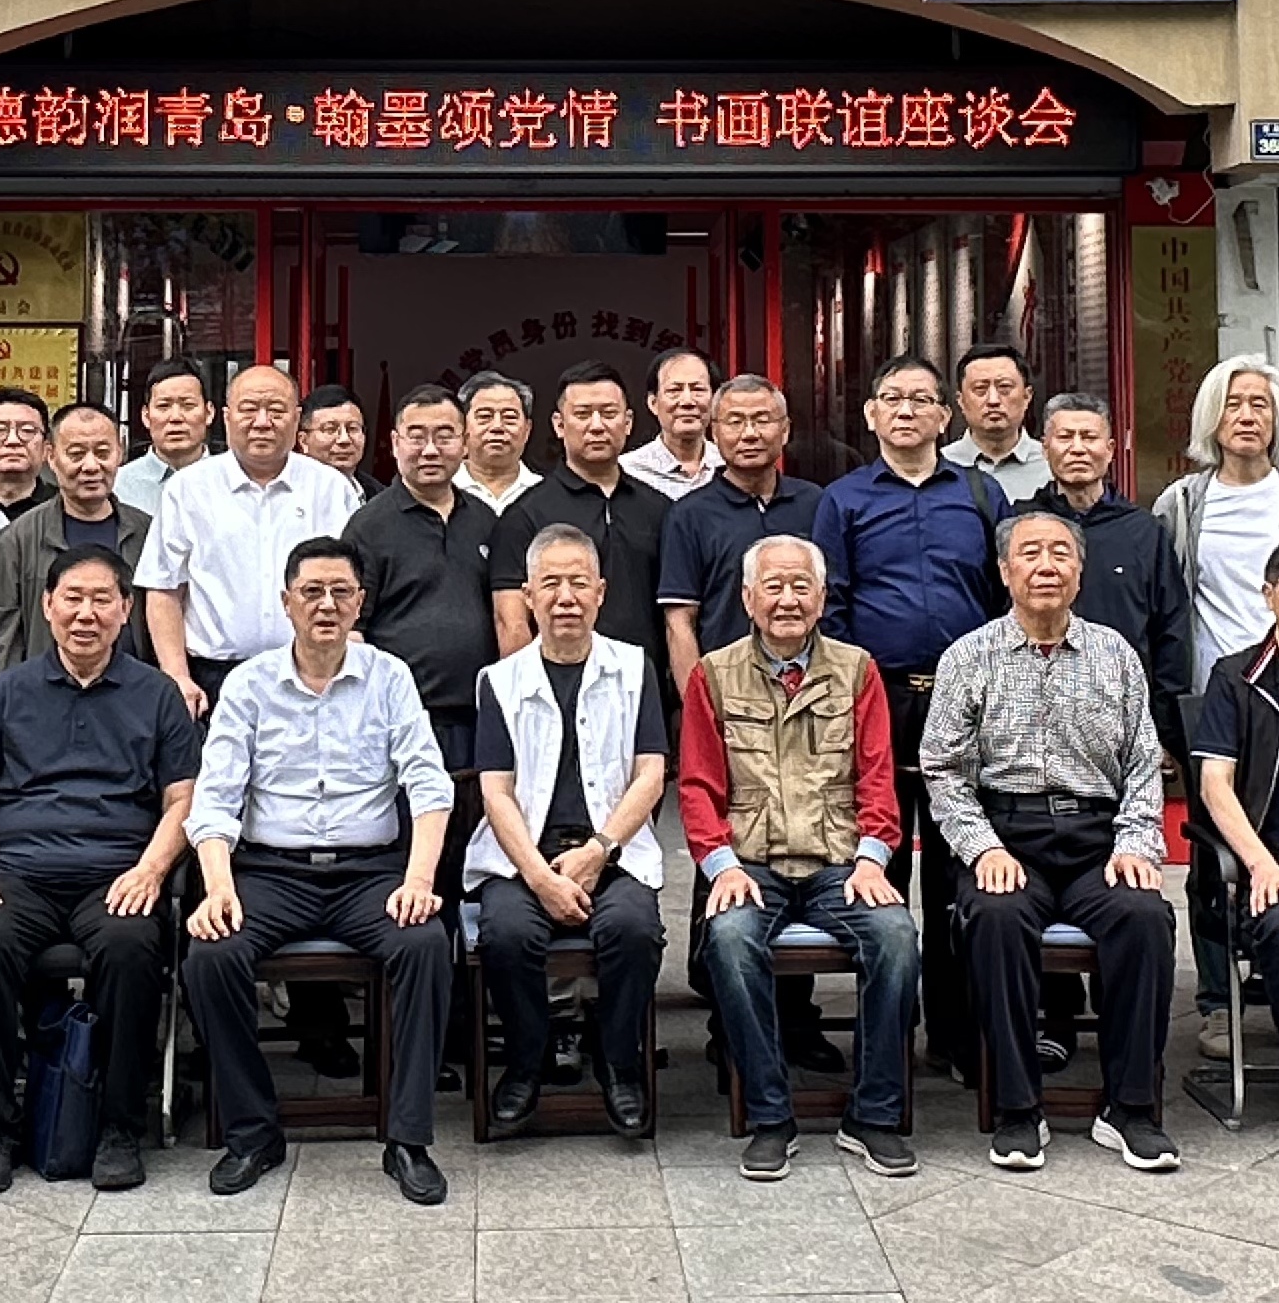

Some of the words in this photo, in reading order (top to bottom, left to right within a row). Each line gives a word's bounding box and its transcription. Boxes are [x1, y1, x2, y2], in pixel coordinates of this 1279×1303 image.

[658, 87, 1075, 148] 书画联谊座谈会
